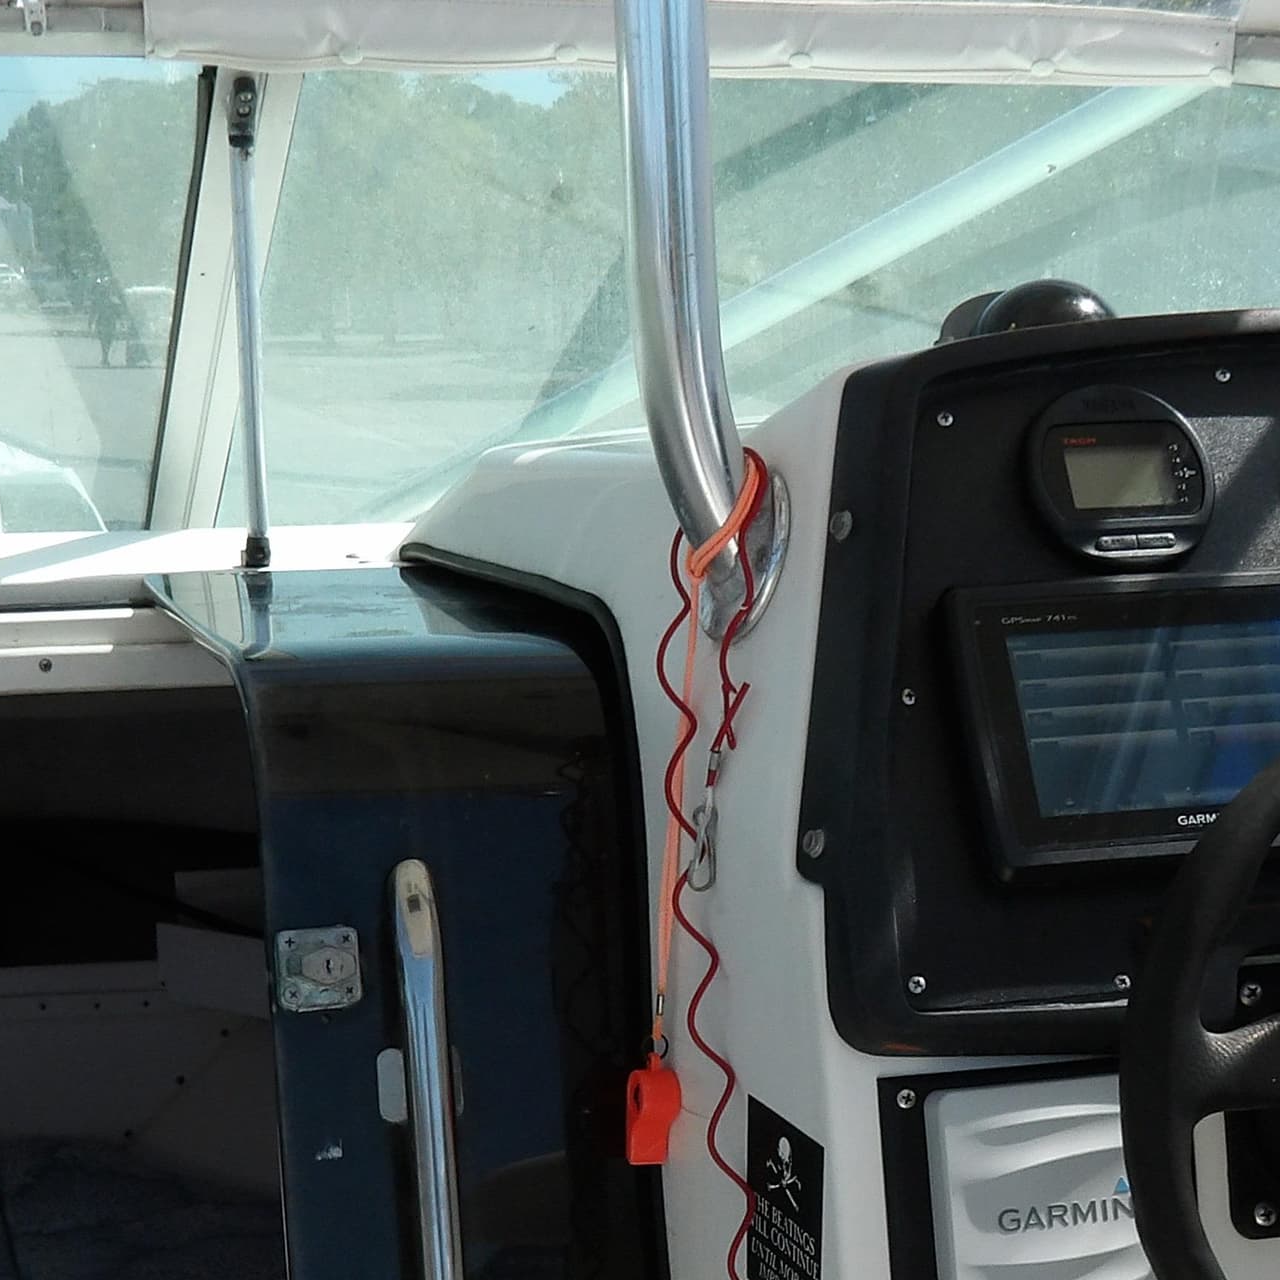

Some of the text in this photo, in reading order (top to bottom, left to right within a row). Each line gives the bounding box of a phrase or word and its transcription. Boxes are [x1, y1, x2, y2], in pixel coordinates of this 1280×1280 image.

[1177, 812, 1220, 826] GARM
[755, 1192, 815, 1256] HE BEATINGS
[998, 1197, 1135, 1232] GARMIN
[751, 1237, 778, 1269] UNTIL
[752, 1212, 819, 1280] ILL CONTINUE
